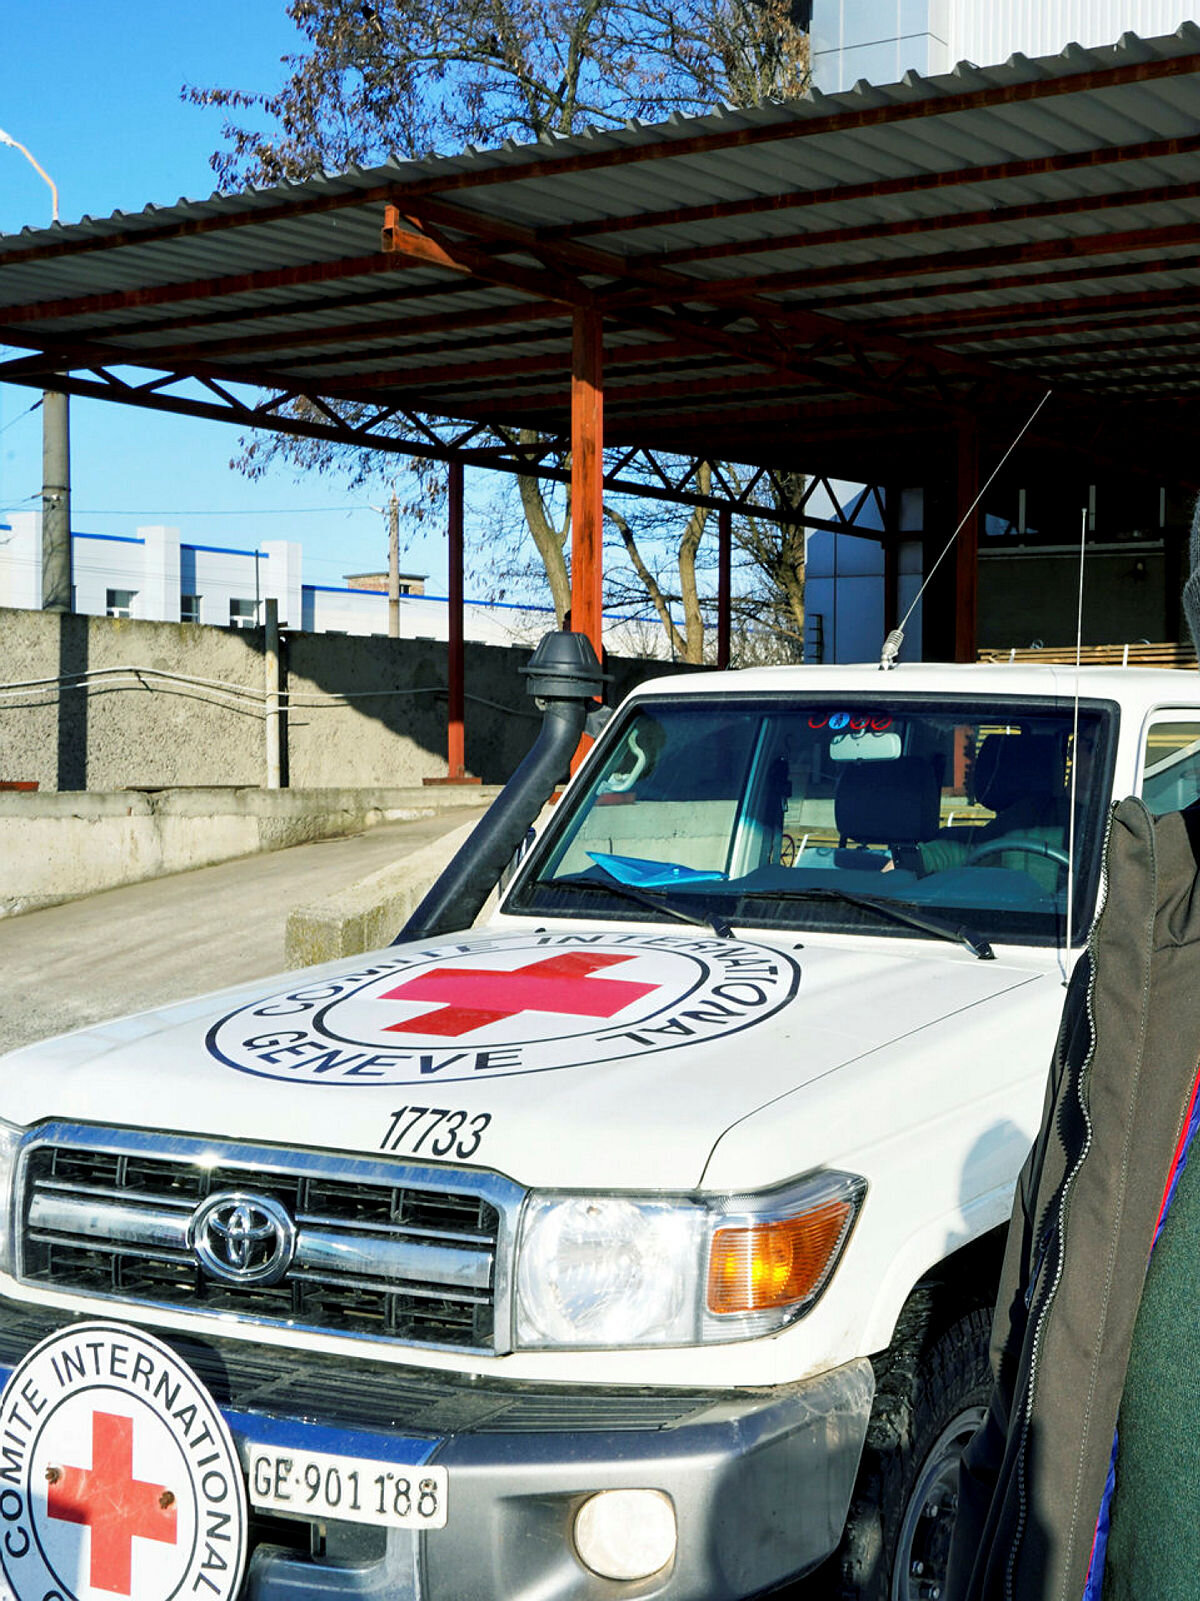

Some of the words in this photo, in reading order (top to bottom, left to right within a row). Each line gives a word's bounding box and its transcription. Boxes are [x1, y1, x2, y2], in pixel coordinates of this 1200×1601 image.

[252, 941, 500, 1017] COMITE
[537, 935, 779, 1046] INTERNATIONAL
[242, 1030, 523, 1076] GENEVE
[380, 1105, 492, 1159] 17733
[0, 1378, 48, 1558] COMITE
[51, 1342, 232, 1596] INTERNATIONAL
[374, 1471, 438, 1518] 188
